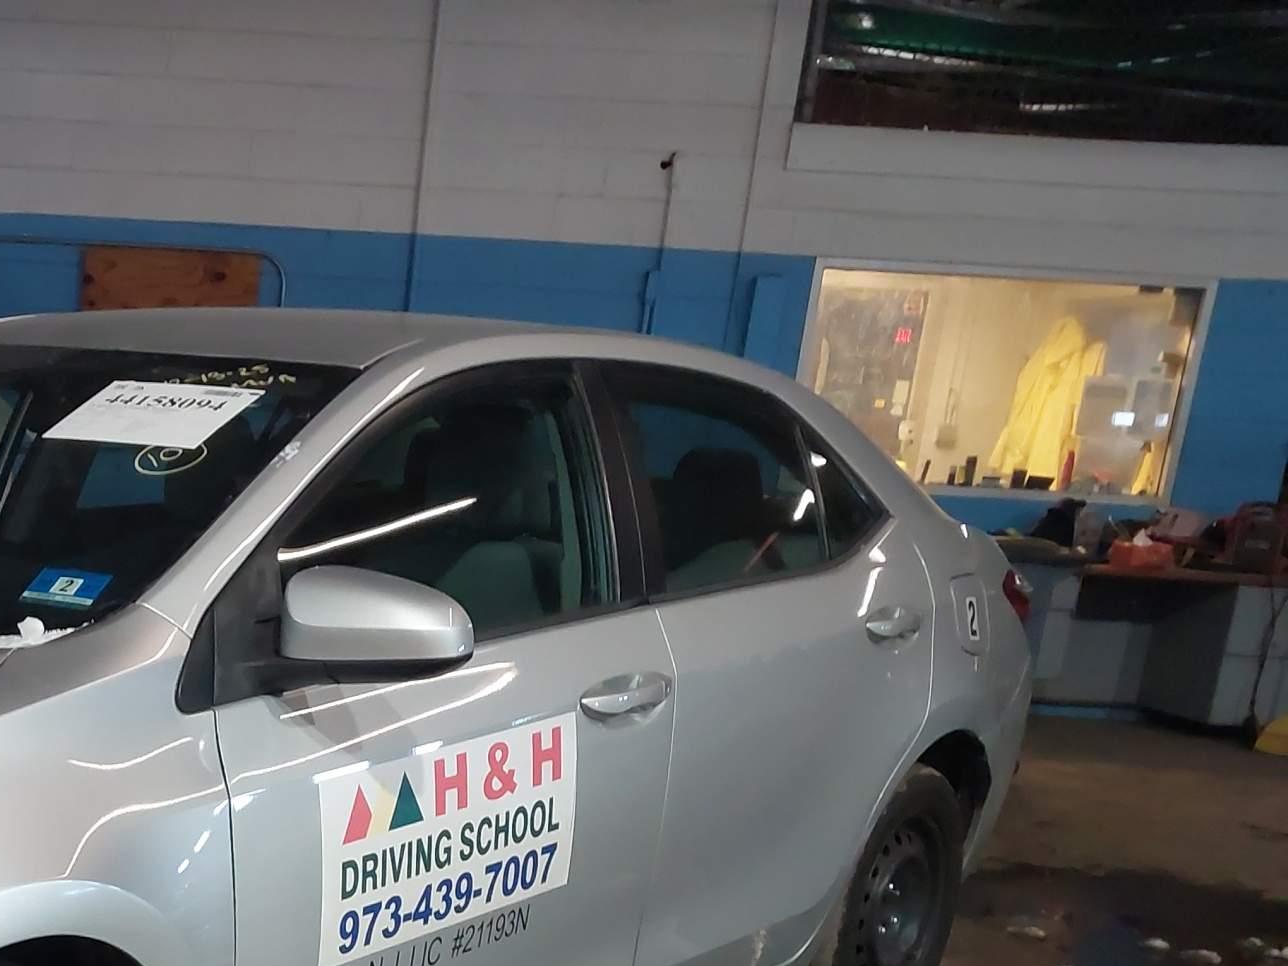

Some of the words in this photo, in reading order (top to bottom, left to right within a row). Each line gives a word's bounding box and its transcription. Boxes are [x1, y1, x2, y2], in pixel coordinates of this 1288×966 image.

[104, 394, 228, 411] 44158094
[58, 579, 75, 592] 2
[433, 752, 468, 816] H
[483, 741, 518, 800] &
[531, 726, 562, 787] H
[340, 829, 452, 901] DRIVING
[459, 797, 560, 862] SCHOOL
[338, 842, 558, 954] 973-439-7007
[450, 904, 531, 959] #21193N
